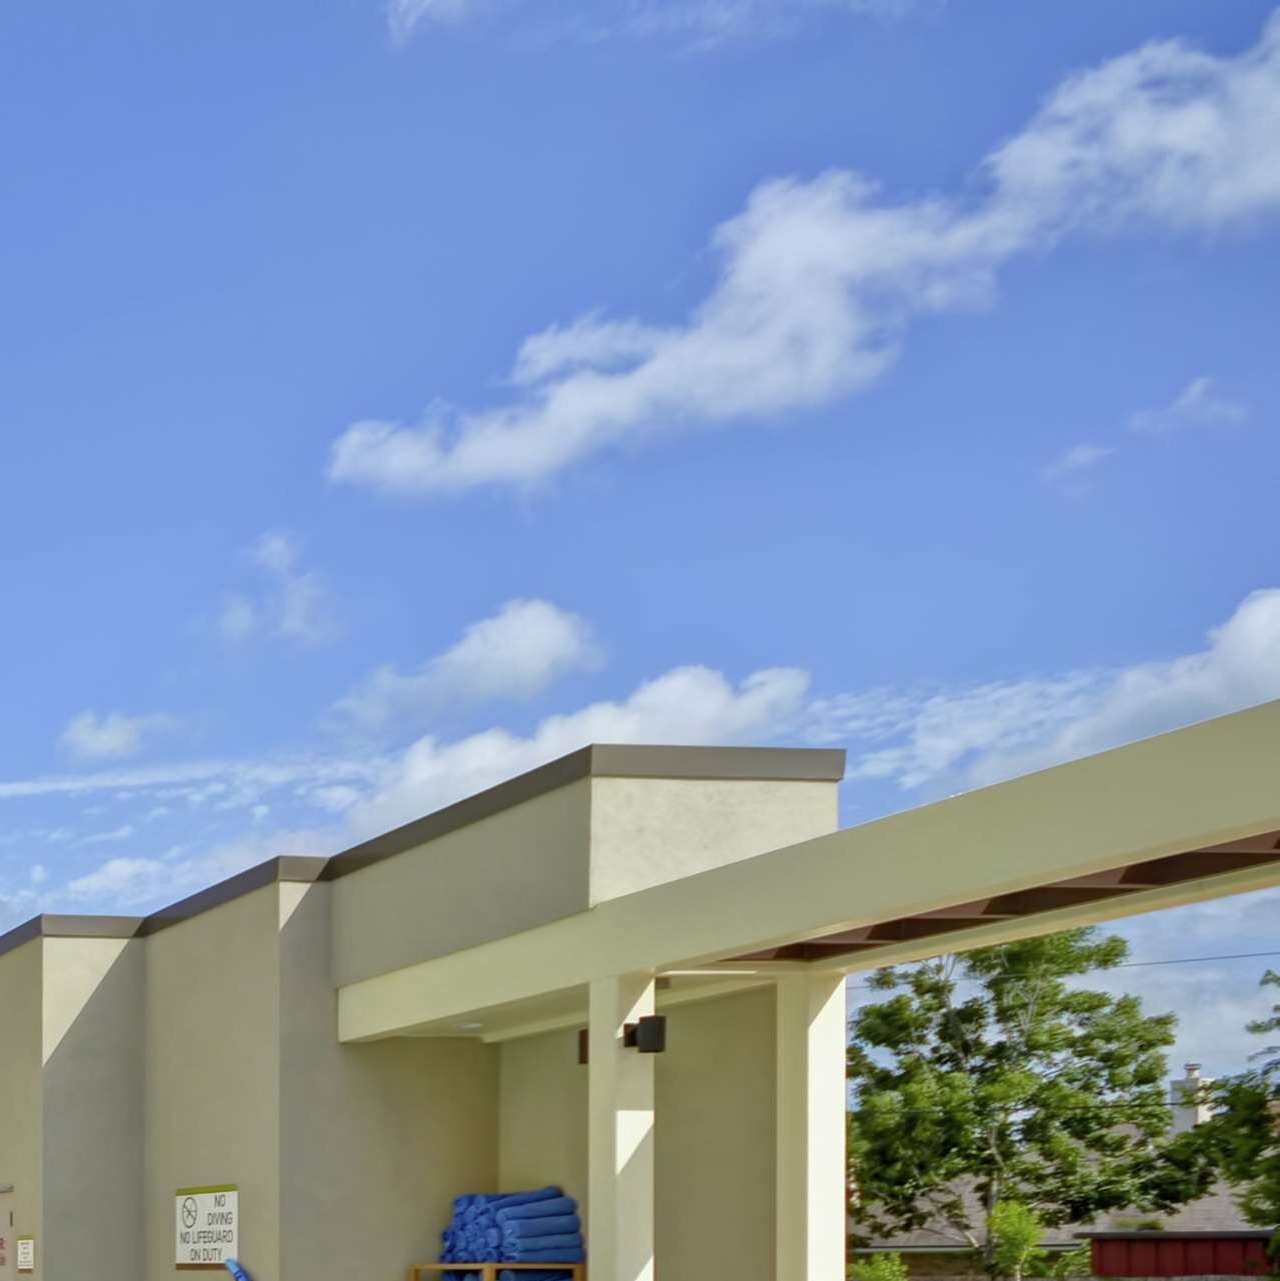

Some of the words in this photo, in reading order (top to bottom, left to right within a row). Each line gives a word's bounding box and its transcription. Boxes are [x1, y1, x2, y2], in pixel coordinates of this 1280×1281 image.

[214, 1194, 226, 1208] NO
[207, 1211, 233, 1226] DIVING
[180, 1231, 191, 1244] NO
[192, 1230, 234, 1244] LIFEGUARD
[190, 1248, 201, 1261] ON
[202, 1247, 223, 1261] DUTY
